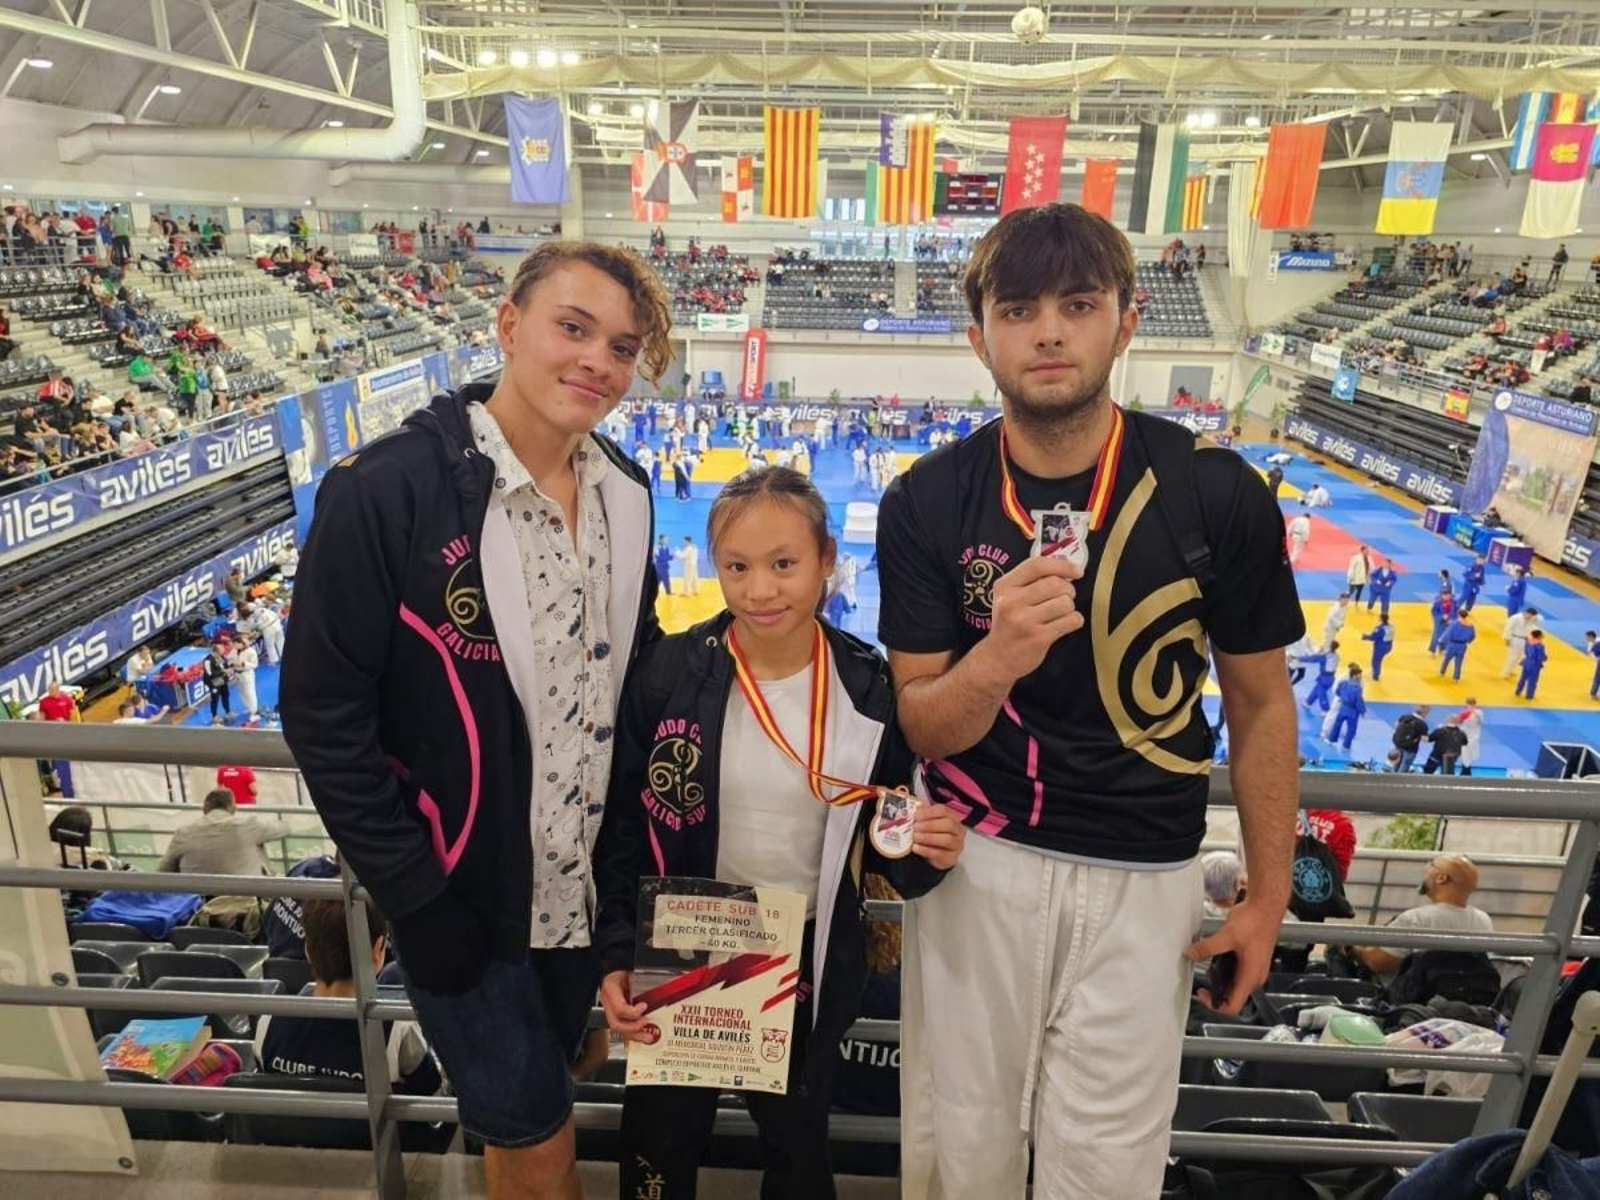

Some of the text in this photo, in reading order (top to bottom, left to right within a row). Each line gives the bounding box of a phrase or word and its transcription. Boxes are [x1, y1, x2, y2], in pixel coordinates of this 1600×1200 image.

[1546, 401, 1592, 422] ASTURIANO
[0, 424, 274, 547] ilés avilés avilés
[1406, 473, 1453, 504] avilés
[978, 544, 1010, 565] CLUB
[131, 571, 214, 642] avilés
[436, 622, 501, 662] GALICIA
[667, 900, 780, 919] CADETE SUB 18
[695, 914, 750, 926] FEMENINO
[666, 925, 777, 941] TERCER CLASIFICADO
[673, 1014, 752, 1030] INTERNACIONAL
[704, 1006, 744, 1019] TORNEO
[673, 1026, 700, 1038] VILLA
[703, 1029, 715, 1039] DE
[718, 1029, 751, 1043] AVILÉS
